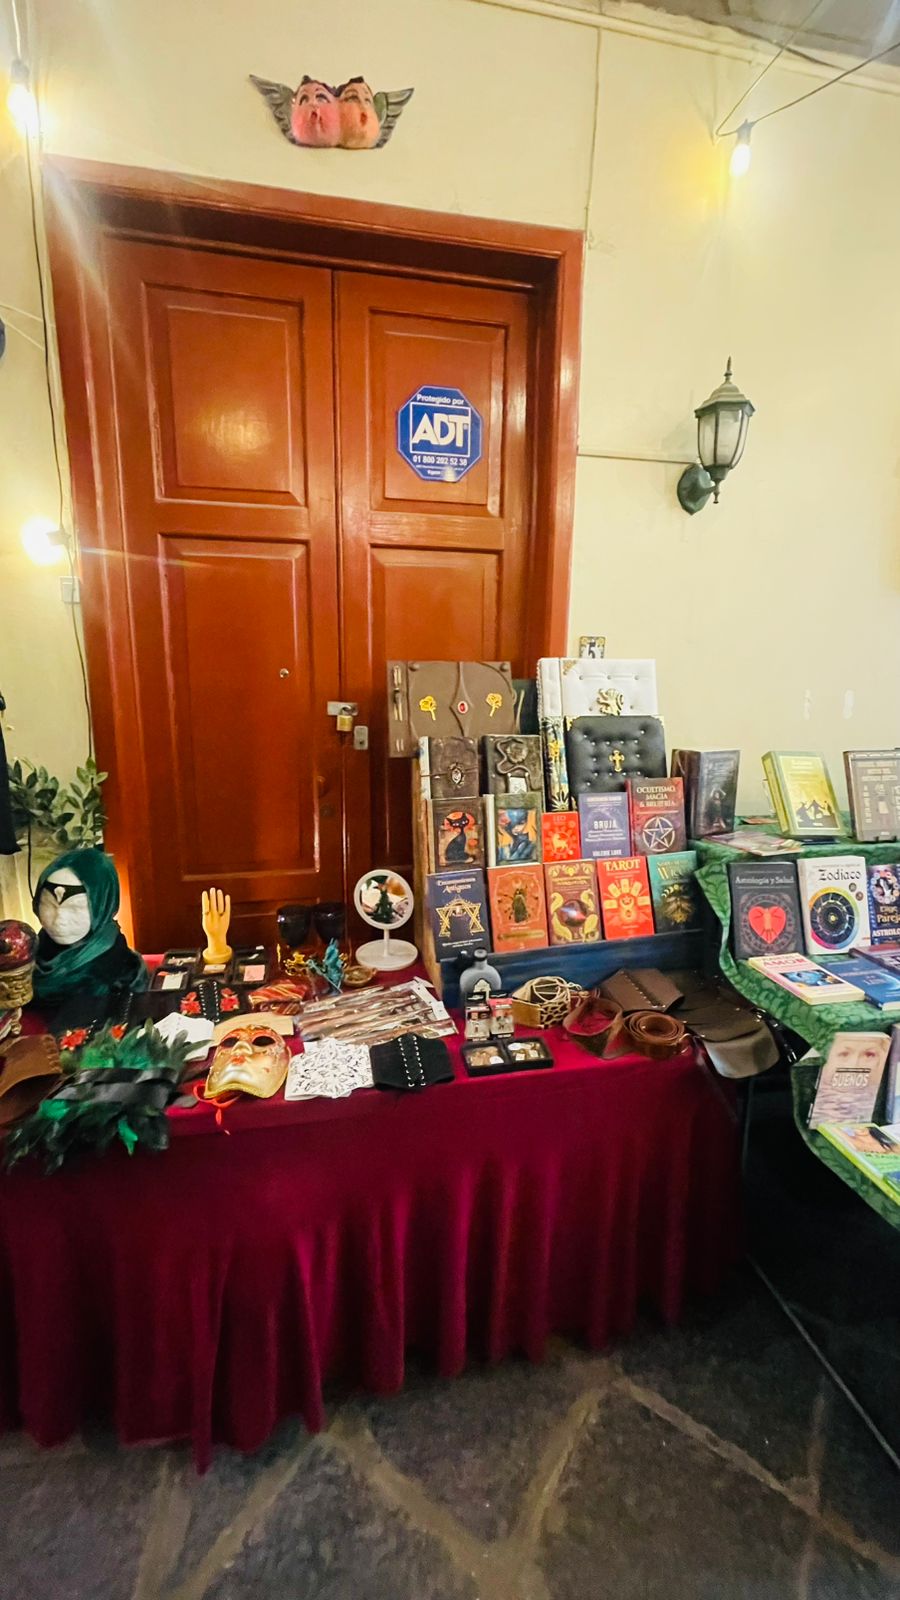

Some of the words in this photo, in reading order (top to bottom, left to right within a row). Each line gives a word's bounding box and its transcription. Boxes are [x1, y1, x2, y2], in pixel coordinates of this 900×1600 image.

[416, 393, 451, 405] Protegido
[411, 412, 469, 448] ADT
[412, 455, 421, 463] 01
[422, 456, 435, 464] 800
[436, 457, 449, 465] 202
[449, 457, 458, 466] 52
[593, 819, 618, 830] BRUJA
[603, 859, 640, 872] TAROT
[775, 875, 795, 884] Salud
[818, 868, 862, 881] Zodiaco
[763, 958, 807, 967] AMOR
